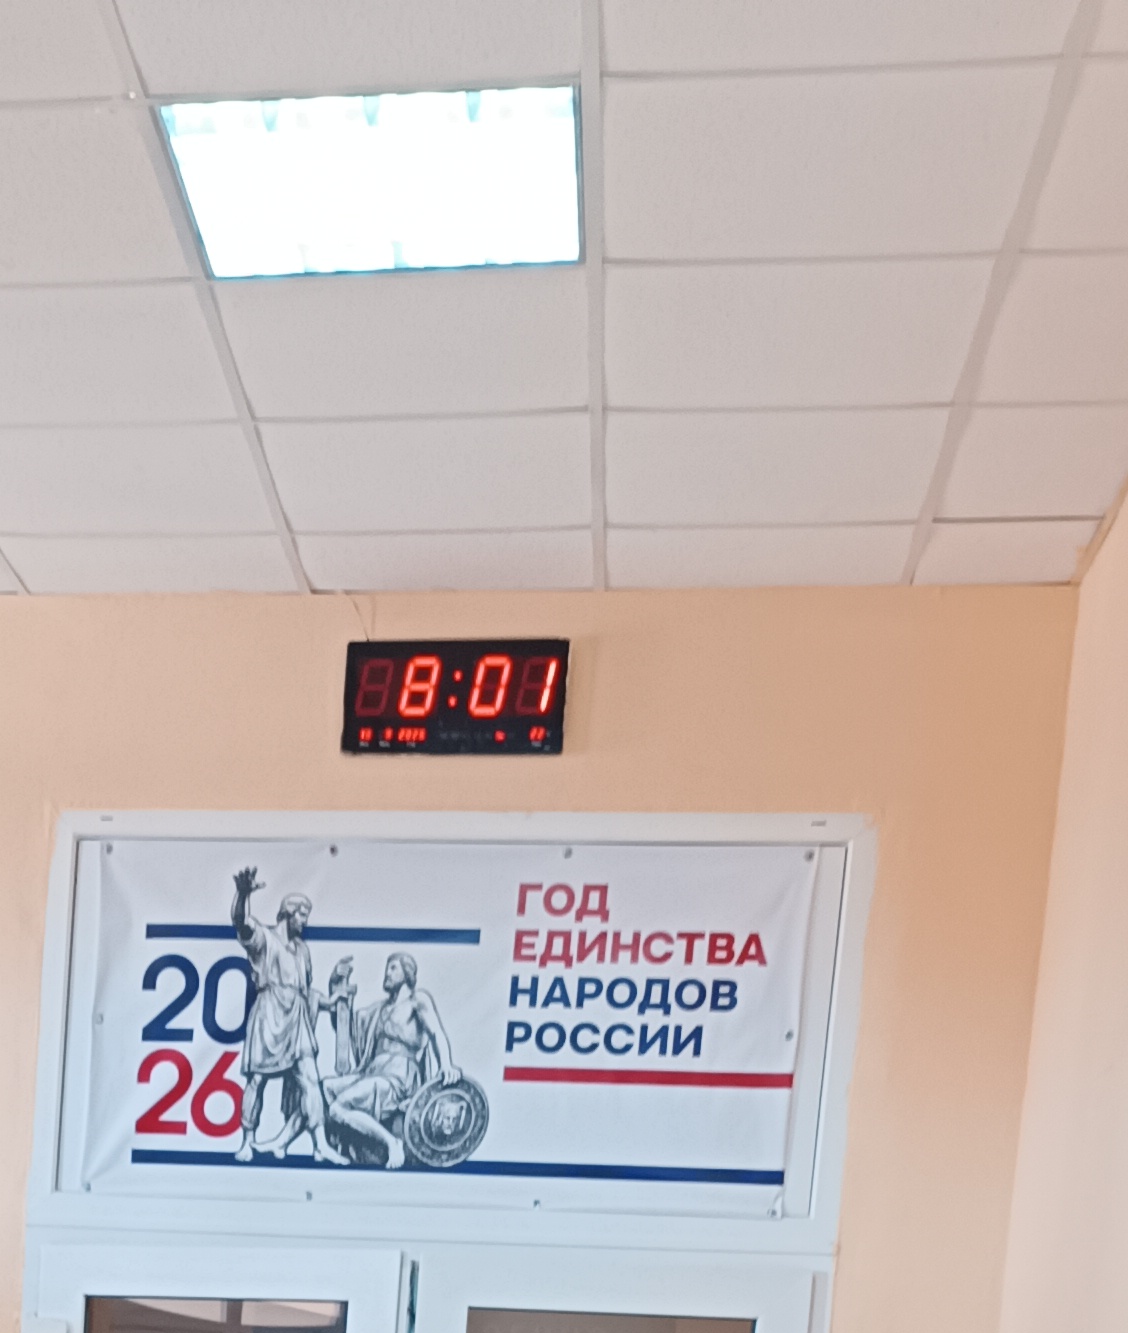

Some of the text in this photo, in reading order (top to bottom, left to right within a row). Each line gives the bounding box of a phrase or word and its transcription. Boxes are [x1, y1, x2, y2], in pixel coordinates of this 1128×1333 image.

[398, 654, 559, 718] 8:01
[516, 882, 610, 924] ГОД
[512, 928, 768, 969] ЕДИНСТВА
[141, 954, 258, 1045] 20
[508, 975, 739, 1017] НАРОДОВ
[504, 1020, 704, 1058] РОССИИ
[134, 1047, 245, 1139] 26
